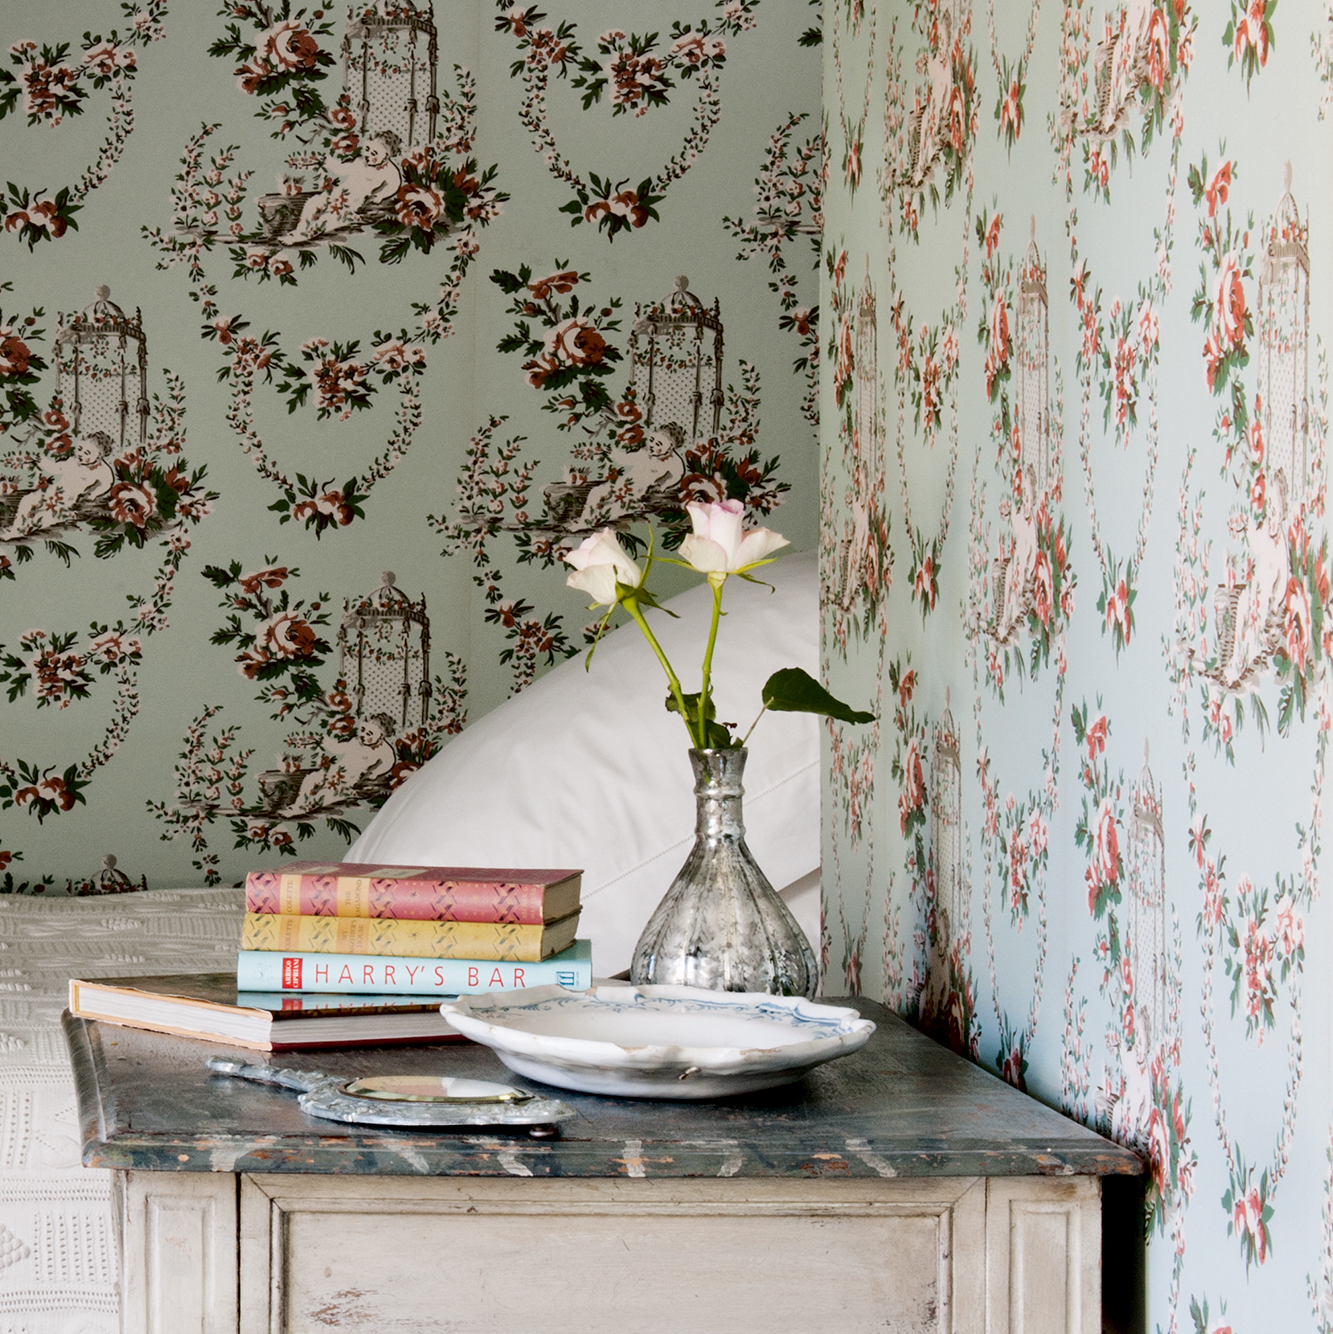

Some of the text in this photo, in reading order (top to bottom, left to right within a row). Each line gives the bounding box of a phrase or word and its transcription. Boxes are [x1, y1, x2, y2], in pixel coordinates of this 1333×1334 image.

[285, 919, 293, 951] COLETTE
[292, 958, 300, 988] CIPRIANI
[315, 963, 526, 988] HARRY'S BAR
